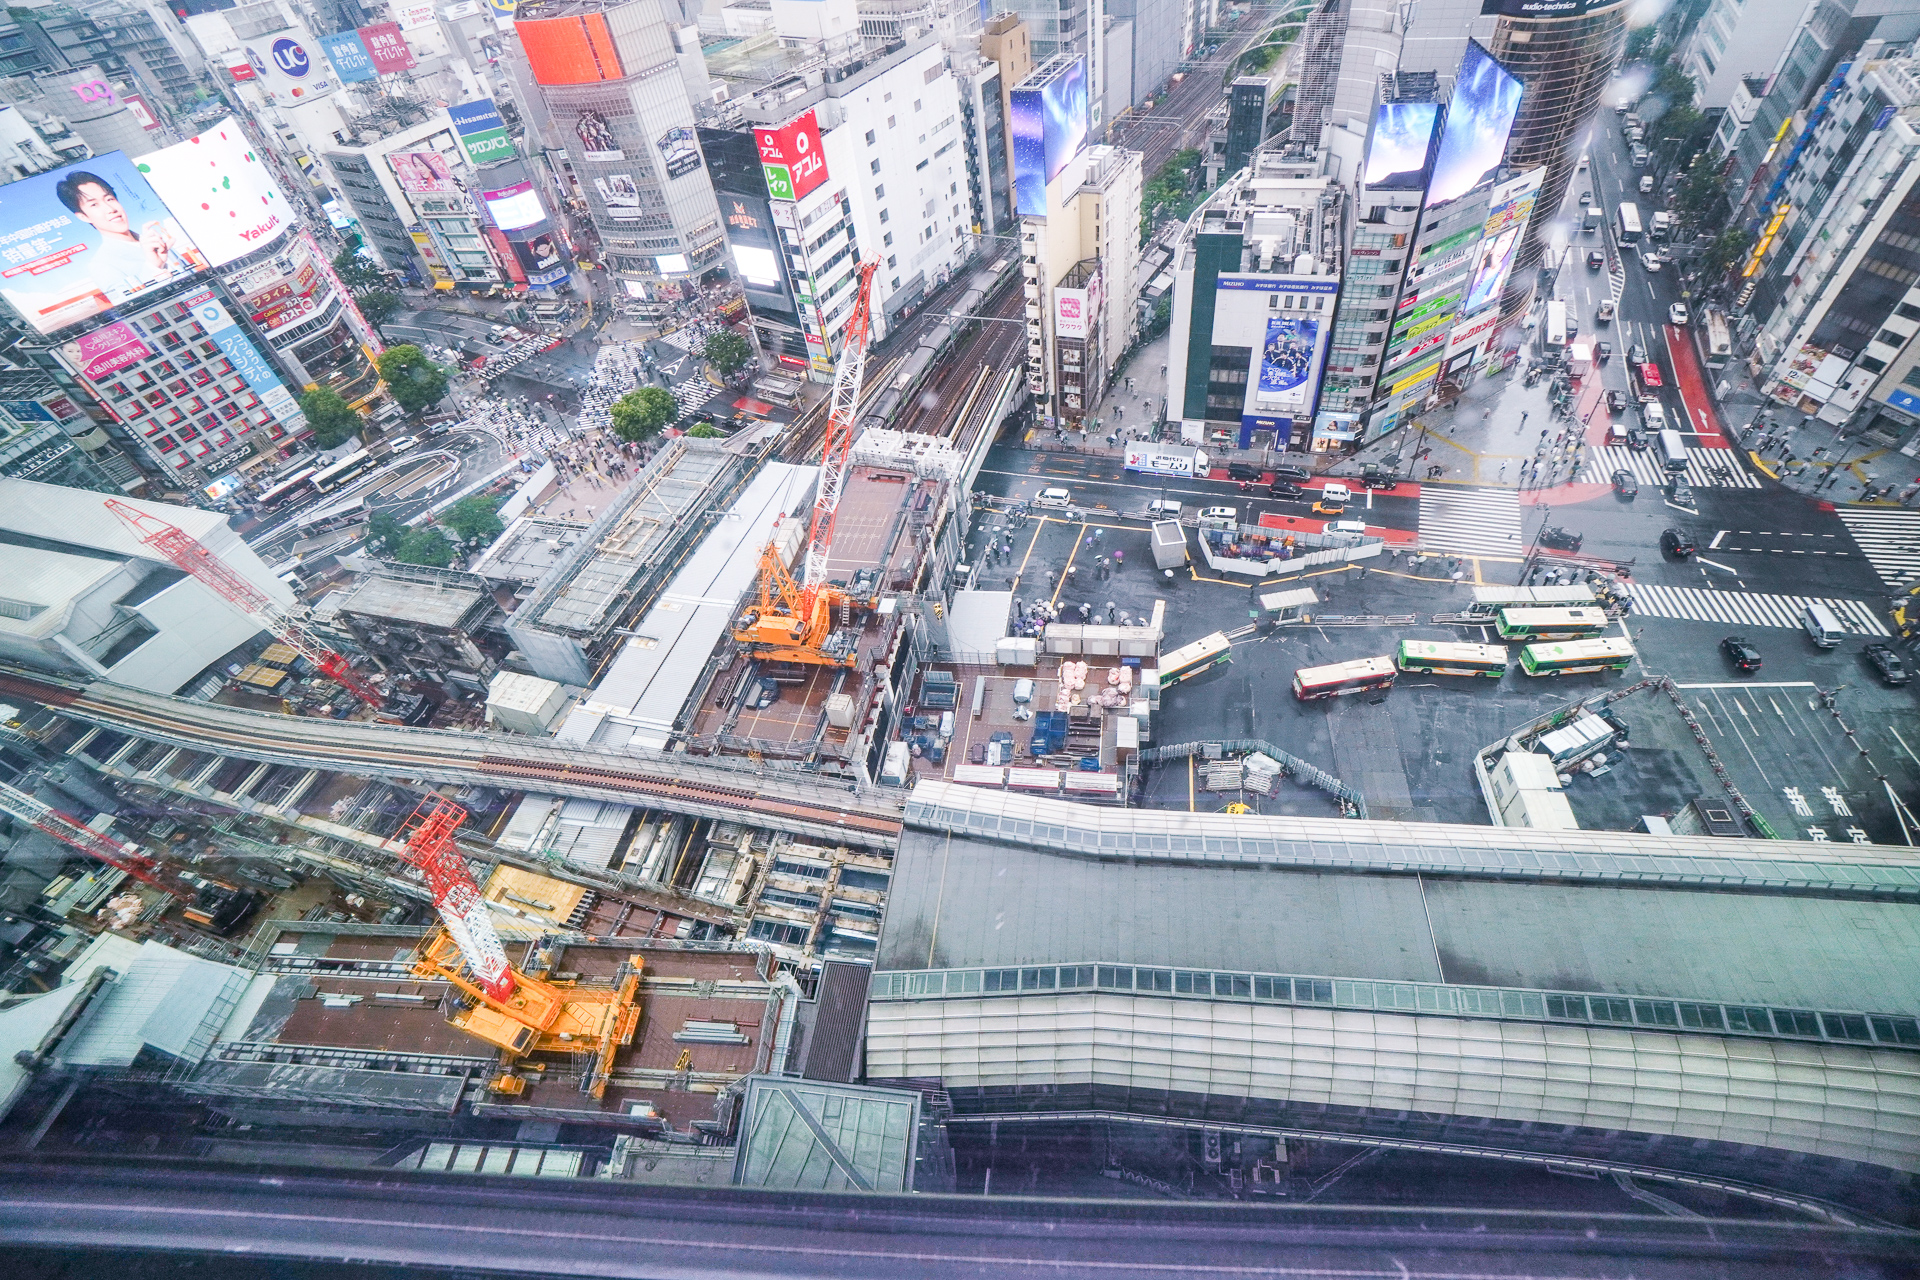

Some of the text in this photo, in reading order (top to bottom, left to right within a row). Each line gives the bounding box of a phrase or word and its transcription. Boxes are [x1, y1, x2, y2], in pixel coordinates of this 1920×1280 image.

[1521, 2, 1577, 11] audio-technica
[331, 41, 359, 58] 龍角散
[370, 33, 398, 49] 龍角散
[273, 46, 307, 70] UC
[71, 80, 115, 106] 109
[312, 81, 329, 90] VISA
[467, 136, 508, 156] サロンパス
[761, 147, 783, 159] アコム
[792, 152, 822, 184] アコム
[239, 215, 280, 241] Yakult
[691, 236, 724, 257] STARBUCKS
[253, 285, 290, 307] プライス
[279, 307, 304, 323] ガスト
[91, 326, 126, 344] 品川スキン
[1452, 316, 1497, 345] ビックカメラ
[98, 333, 128, 350] クリニック
[92, 346, 146, 375] 品川美容外科
[220, 338, 262, 383] アイシティ
[46, 442, 72, 459] CITY
[208, 445, 252, 472] サンドラッグ
[1150, 460, 1188, 471] モームリ
